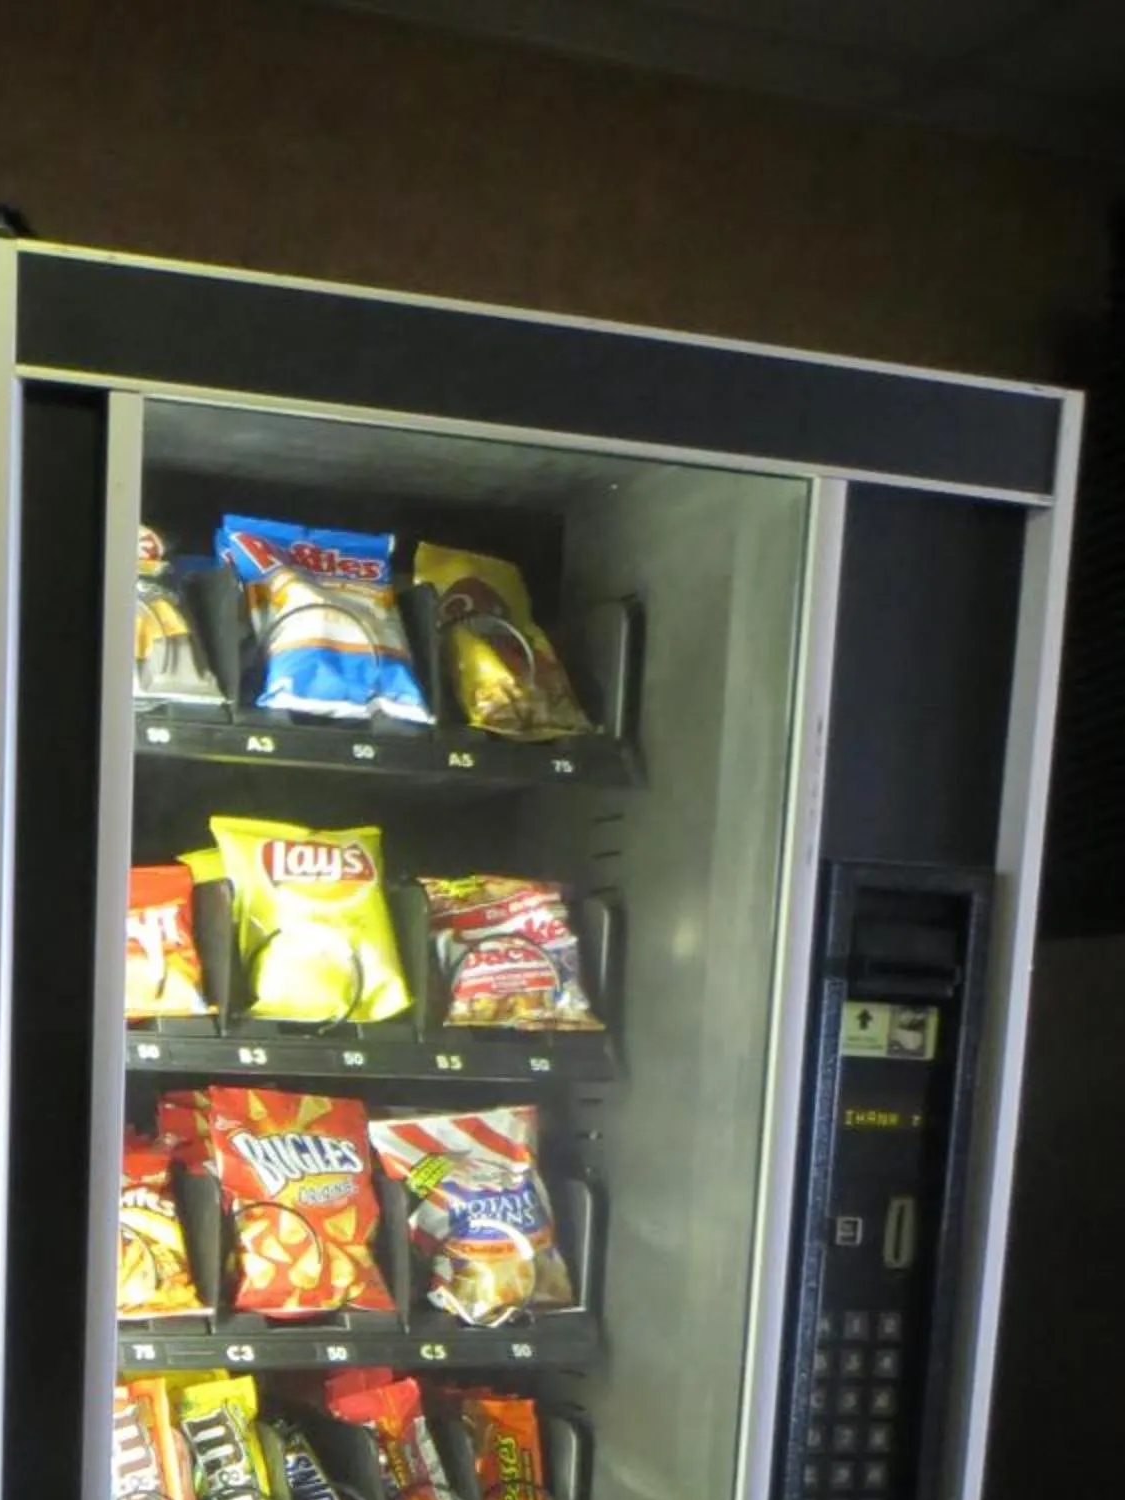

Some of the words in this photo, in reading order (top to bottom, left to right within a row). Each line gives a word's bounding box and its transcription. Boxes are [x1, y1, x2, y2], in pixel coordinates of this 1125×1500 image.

[247, 736, 274, 753] A3
[353, 744, 375, 759] 50
[449, 752, 474, 768] A5
[551, 759, 573, 773] 75
[238, 1047, 268, 1065] B3
[343, 1050, 365, 1066] 50
[530, 1057, 551, 1072] 50
[232, 1132, 364, 1197] BUGLES
[227, 1346, 255, 1362] C3
[327, 1346, 349, 1361] 50
[420, 1345, 447, 1360] C5
[511, 1344, 533, 1359] 50
